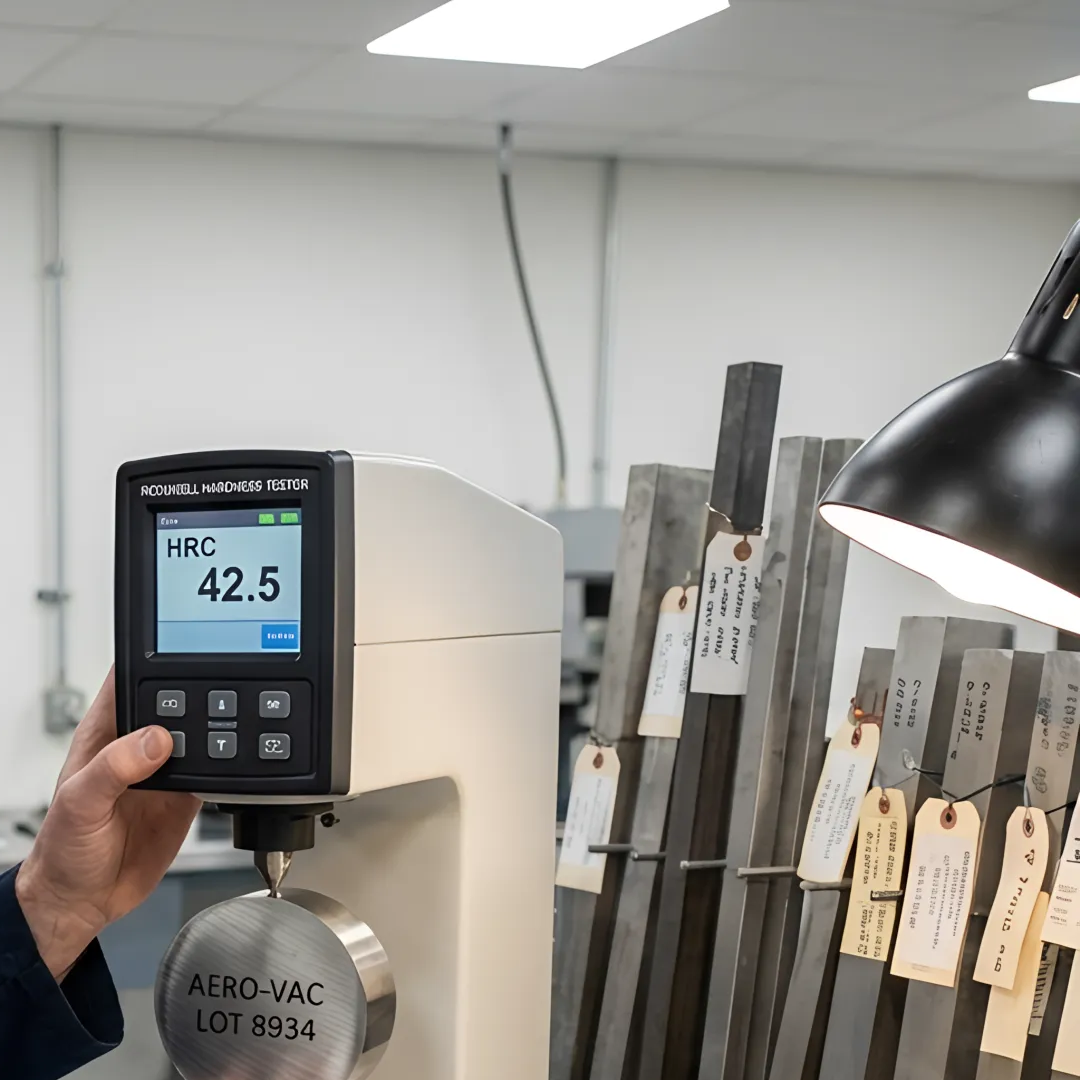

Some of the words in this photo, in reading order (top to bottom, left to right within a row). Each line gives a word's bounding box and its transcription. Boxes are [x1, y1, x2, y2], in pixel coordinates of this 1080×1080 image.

[166, 536, 217, 558] HRC
[197, 565, 281, 602] 42.5
[187, 973, 325, 1006] AERO-VAC
[196, 1008, 243, 1035] LOT
[251, 1014, 316, 1042] 8934
